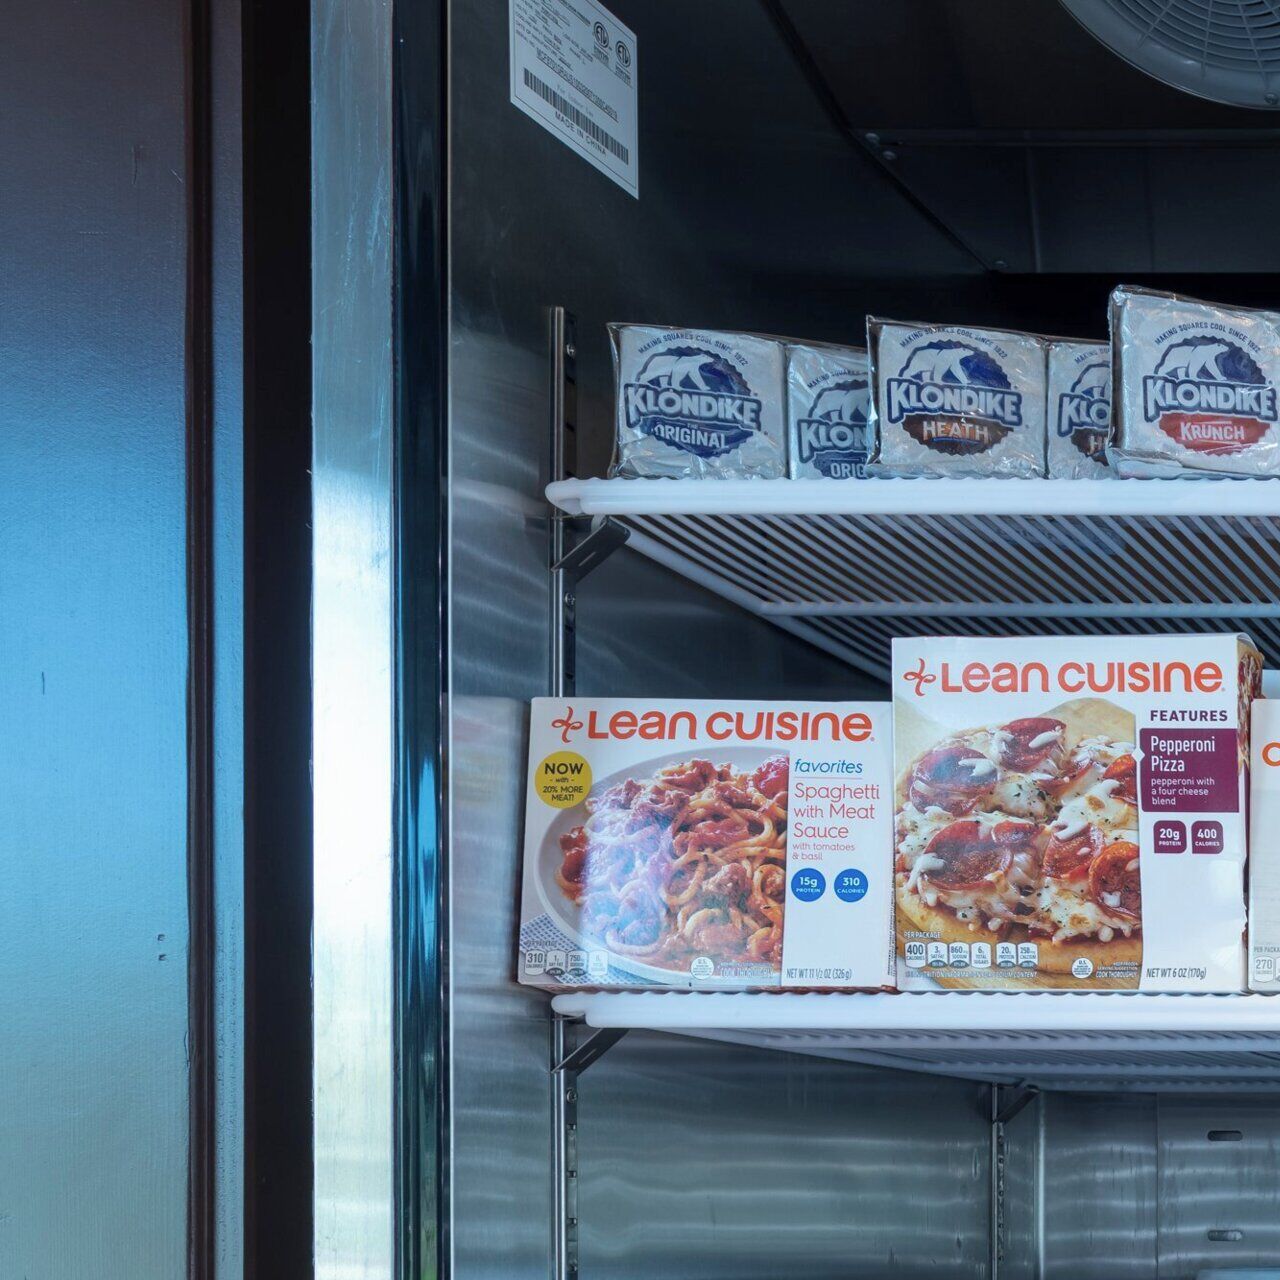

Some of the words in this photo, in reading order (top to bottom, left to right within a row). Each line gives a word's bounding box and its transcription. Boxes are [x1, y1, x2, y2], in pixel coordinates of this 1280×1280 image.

[555, 111, 575, 131] MADE
[577, 129, 584, 139] IN
[586, 133, 607, 156] CHINA
[1155, 327, 1178, 346] MAKING
[1179, 322, 1208, 334] SQUARES
[1210, 322, 1226, 333] COOL
[1228, 327, 1248, 345] SINCE
[626, 385, 760, 428] KLONDIKE
[889, 380, 1021, 424] KLONDIKE
[1145, 377, 1277, 422] KLONDIKE
[922, 420, 989, 442] HEATH
[1180, 421, 1245, 441] KRUNCH
[1150, 710, 1228, 722] FEATURES
[1151, 735, 1216, 758] Pepperoni
[544, 762, 584, 775] NOW
[795, 759, 863, 774] favorites
[1151, 755, 1186, 773] Pizza
[1151, 778, 1194, 789] pepperoni
[1196, 777, 1216, 786] with
[794, 782, 880, 802] Spaghetti
[1158, 787, 1176, 796] four
[1178, 787, 1209, 796] cheese
[1152, 796, 1176, 806] blend
[793, 805, 824, 819] with
[828, 804, 875, 819] Meat
[793, 822, 849, 839] Sauce
[1159, 828, 1181, 842] 20g
[1197, 828, 1217, 840] 400
[792, 842, 810, 851] with
[811, 842, 855, 851] tomatoes
[792, 852, 800, 861] &
[801, 852, 823, 861] basil
[799, 876, 818, 889] 15g
[842, 876, 861, 887] 310
[1146, 968, 1159, 978] NET
[1160, 968, 1172, 978] WT
[1172, 968, 1177, 978] 6
[1178, 968, 1187, 978] OZ
[1188, 967, 1207, 982] (170g)
